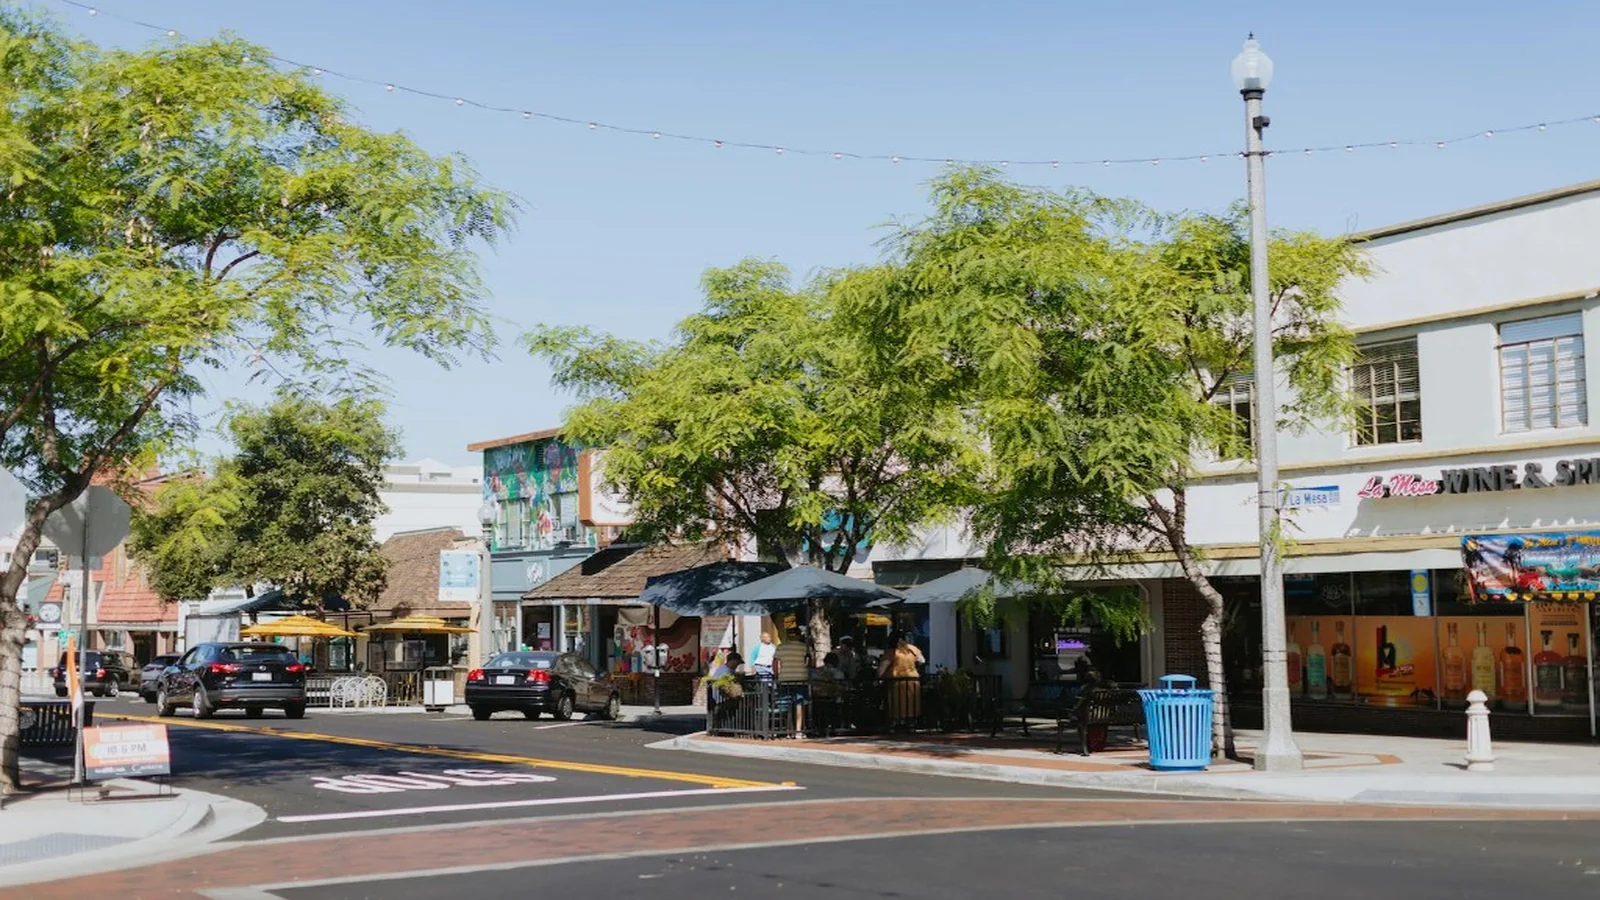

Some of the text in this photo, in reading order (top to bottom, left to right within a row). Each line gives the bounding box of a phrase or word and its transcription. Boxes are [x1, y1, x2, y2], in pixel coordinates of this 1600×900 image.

[1357, 475, 1385, 499] La
[1388, 473, 1438, 497] Mesa
[1441, 464, 1520, 494] WINE
[1523, 462, 1550, 489] &
[1290, 494, 1301, 506] La
[1304, 493, 1328, 505] Mesa
